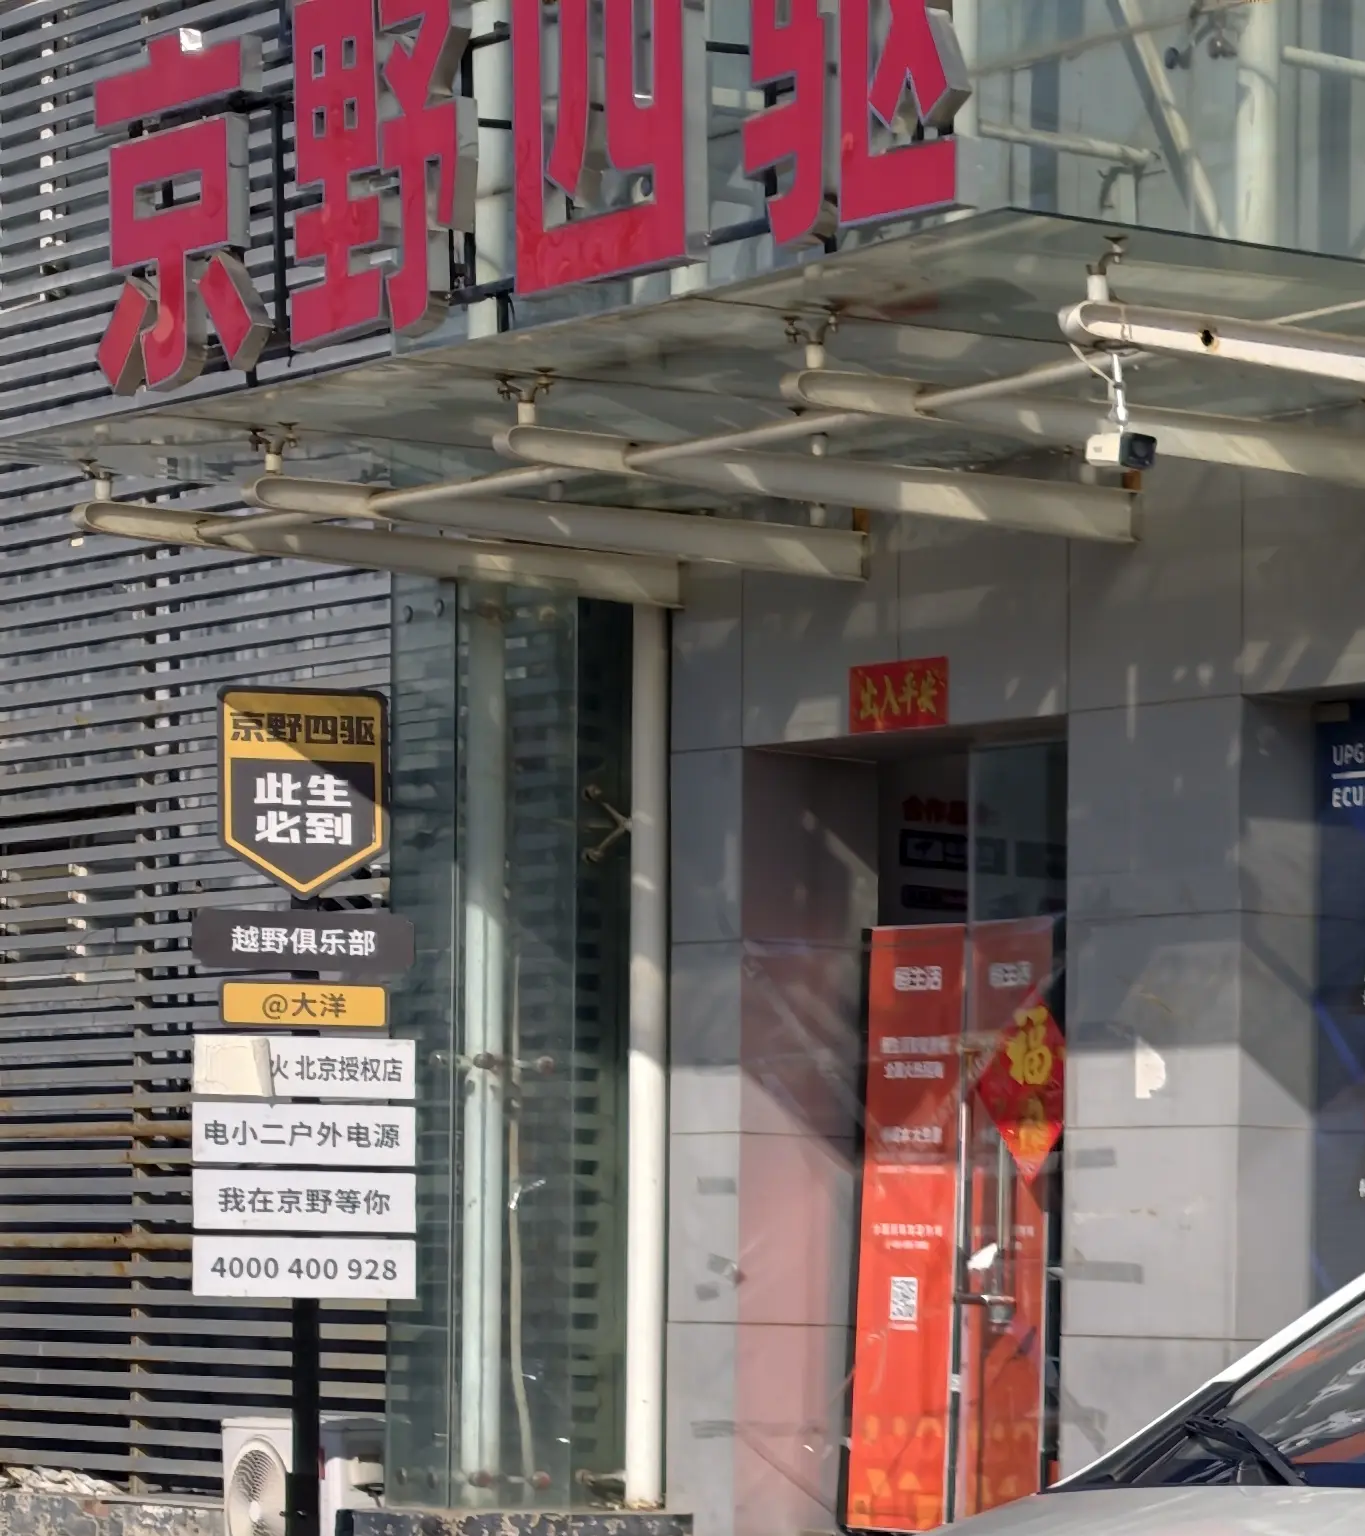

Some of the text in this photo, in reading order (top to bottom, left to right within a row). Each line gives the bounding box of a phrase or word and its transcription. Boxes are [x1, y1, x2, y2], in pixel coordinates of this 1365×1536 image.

[93, 0, 968, 394] 京野四驱
[860, 669, 938, 720] 出入平安
[230, 711, 376, 747] 京野四驱
[254, 772, 353, 809] 此生
[255, 811, 353, 847] 必到
[230, 925, 376, 957] 越野俱乐部
[261, 993, 347, 1020] @大洋
[1006, 1005, 1054, 1086] 福
[294, 1055, 403, 1083] 北京授权店
[203, 1120, 400, 1149] 电小二户外电源
[217, 1187, 391, 1216] 我在京野等你
[210, 1255, 398, 1281] 4000 400 928
